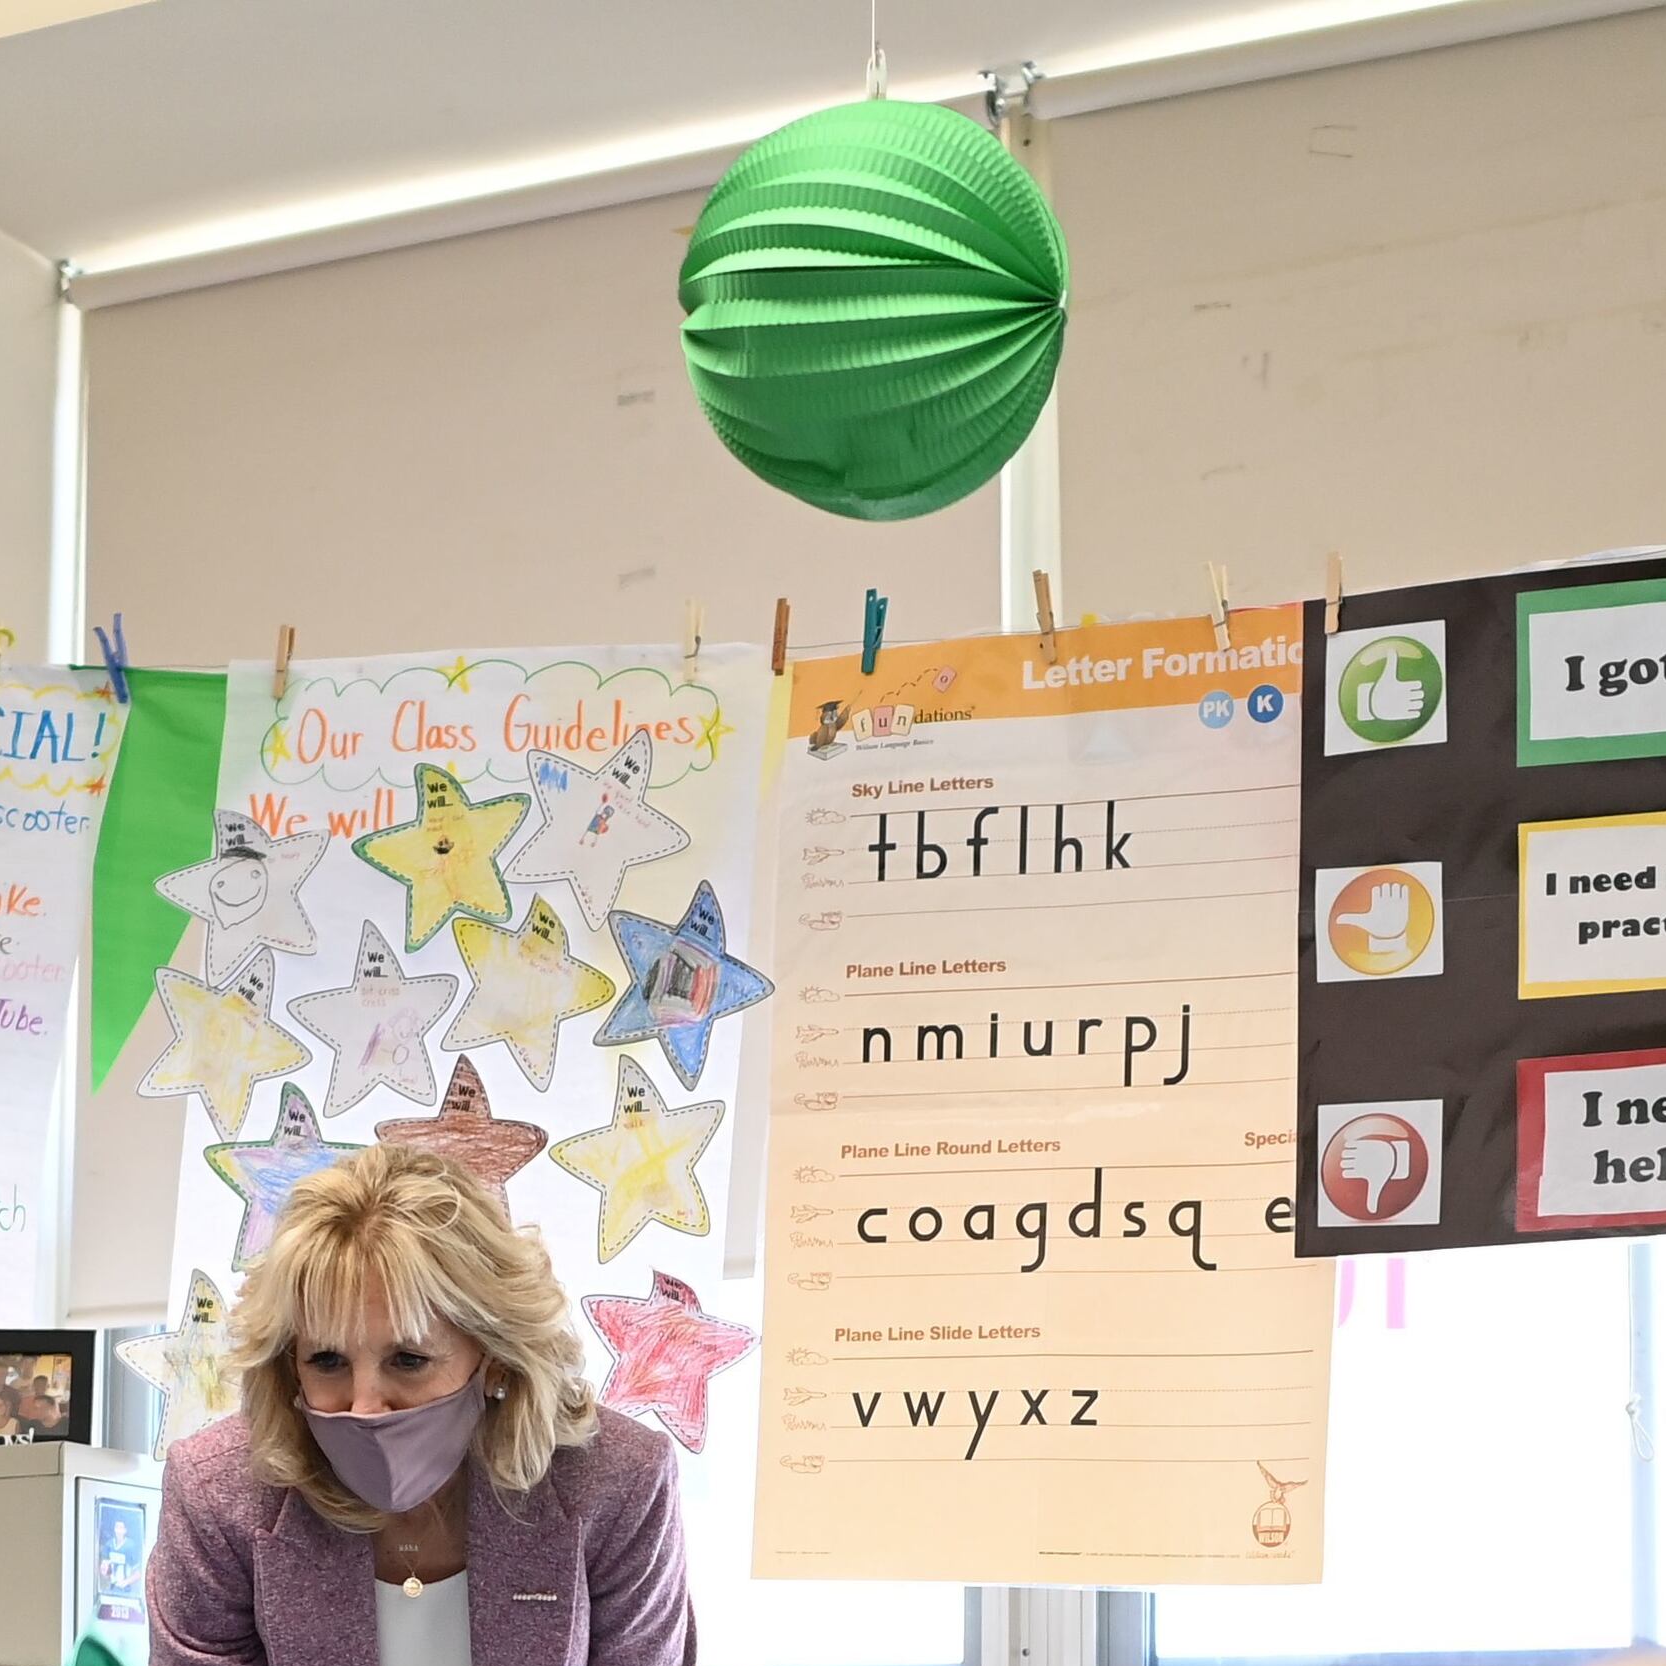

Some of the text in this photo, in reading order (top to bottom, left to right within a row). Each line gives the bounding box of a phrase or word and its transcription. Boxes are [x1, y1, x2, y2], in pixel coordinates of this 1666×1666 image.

[1022, 648, 1132, 691] Letter
[1565, 655, 1586, 691] I
[1203, 699, 1231, 719] PK
[1256, 694, 1275, 713] K
[297, 708, 364, 765] Our
[393, 699, 476, 753] Class
[624, 755, 641, 775] We
[427, 782, 447, 793] We
[851, 774, 994, 800] Sky Line Letters
[248, 788, 394, 839] We will
[226, 822, 246, 832] We
[1545, 872, 1558, 896] I
[1568, 865, 1656, 895] need
[539, 911, 555, 929] We
[698, 907, 714, 925] We
[367, 951, 385, 963] We
[845, 957, 1007, 980] Plane Line Letters
[248, 973, 264, 991] We
[628, 1085, 646, 1098] We
[1582, 1091, 1603, 1128] I
[841, 1137, 1062, 1160] Plane Line Round Letters
[196, 1297, 214, 1311] We
[834, 1323, 1041, 1343] Plane Line Slide Letters
